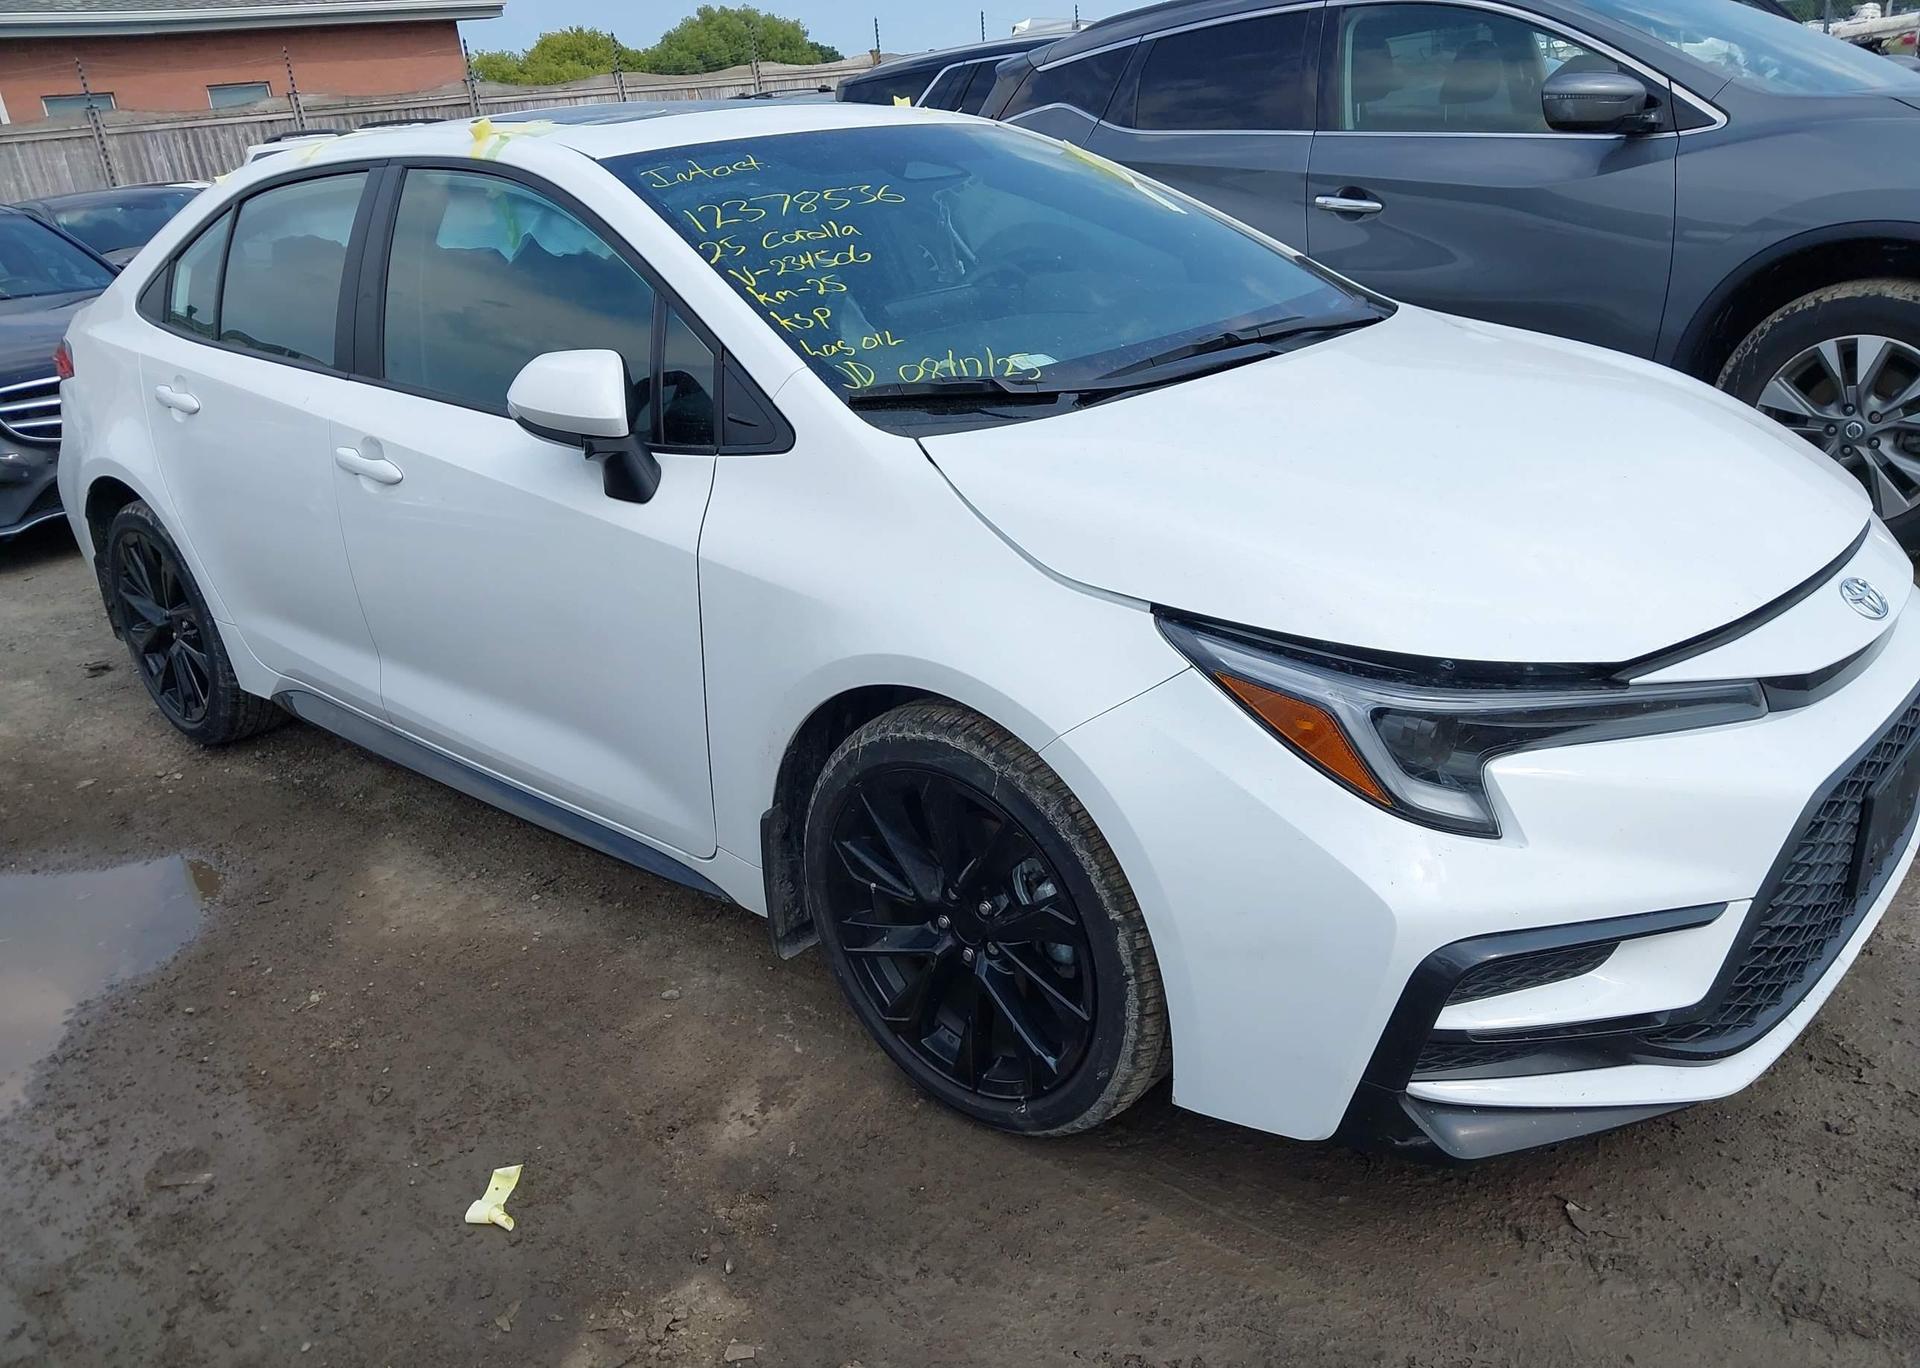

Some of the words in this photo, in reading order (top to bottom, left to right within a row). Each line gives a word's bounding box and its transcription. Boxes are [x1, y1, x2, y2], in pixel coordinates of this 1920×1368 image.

[640, 154, 764, 189] Intact
[682, 184, 907, 233] 12378536
[699, 234, 746, 265] 25
[762, 220, 863, 250] Corolla
